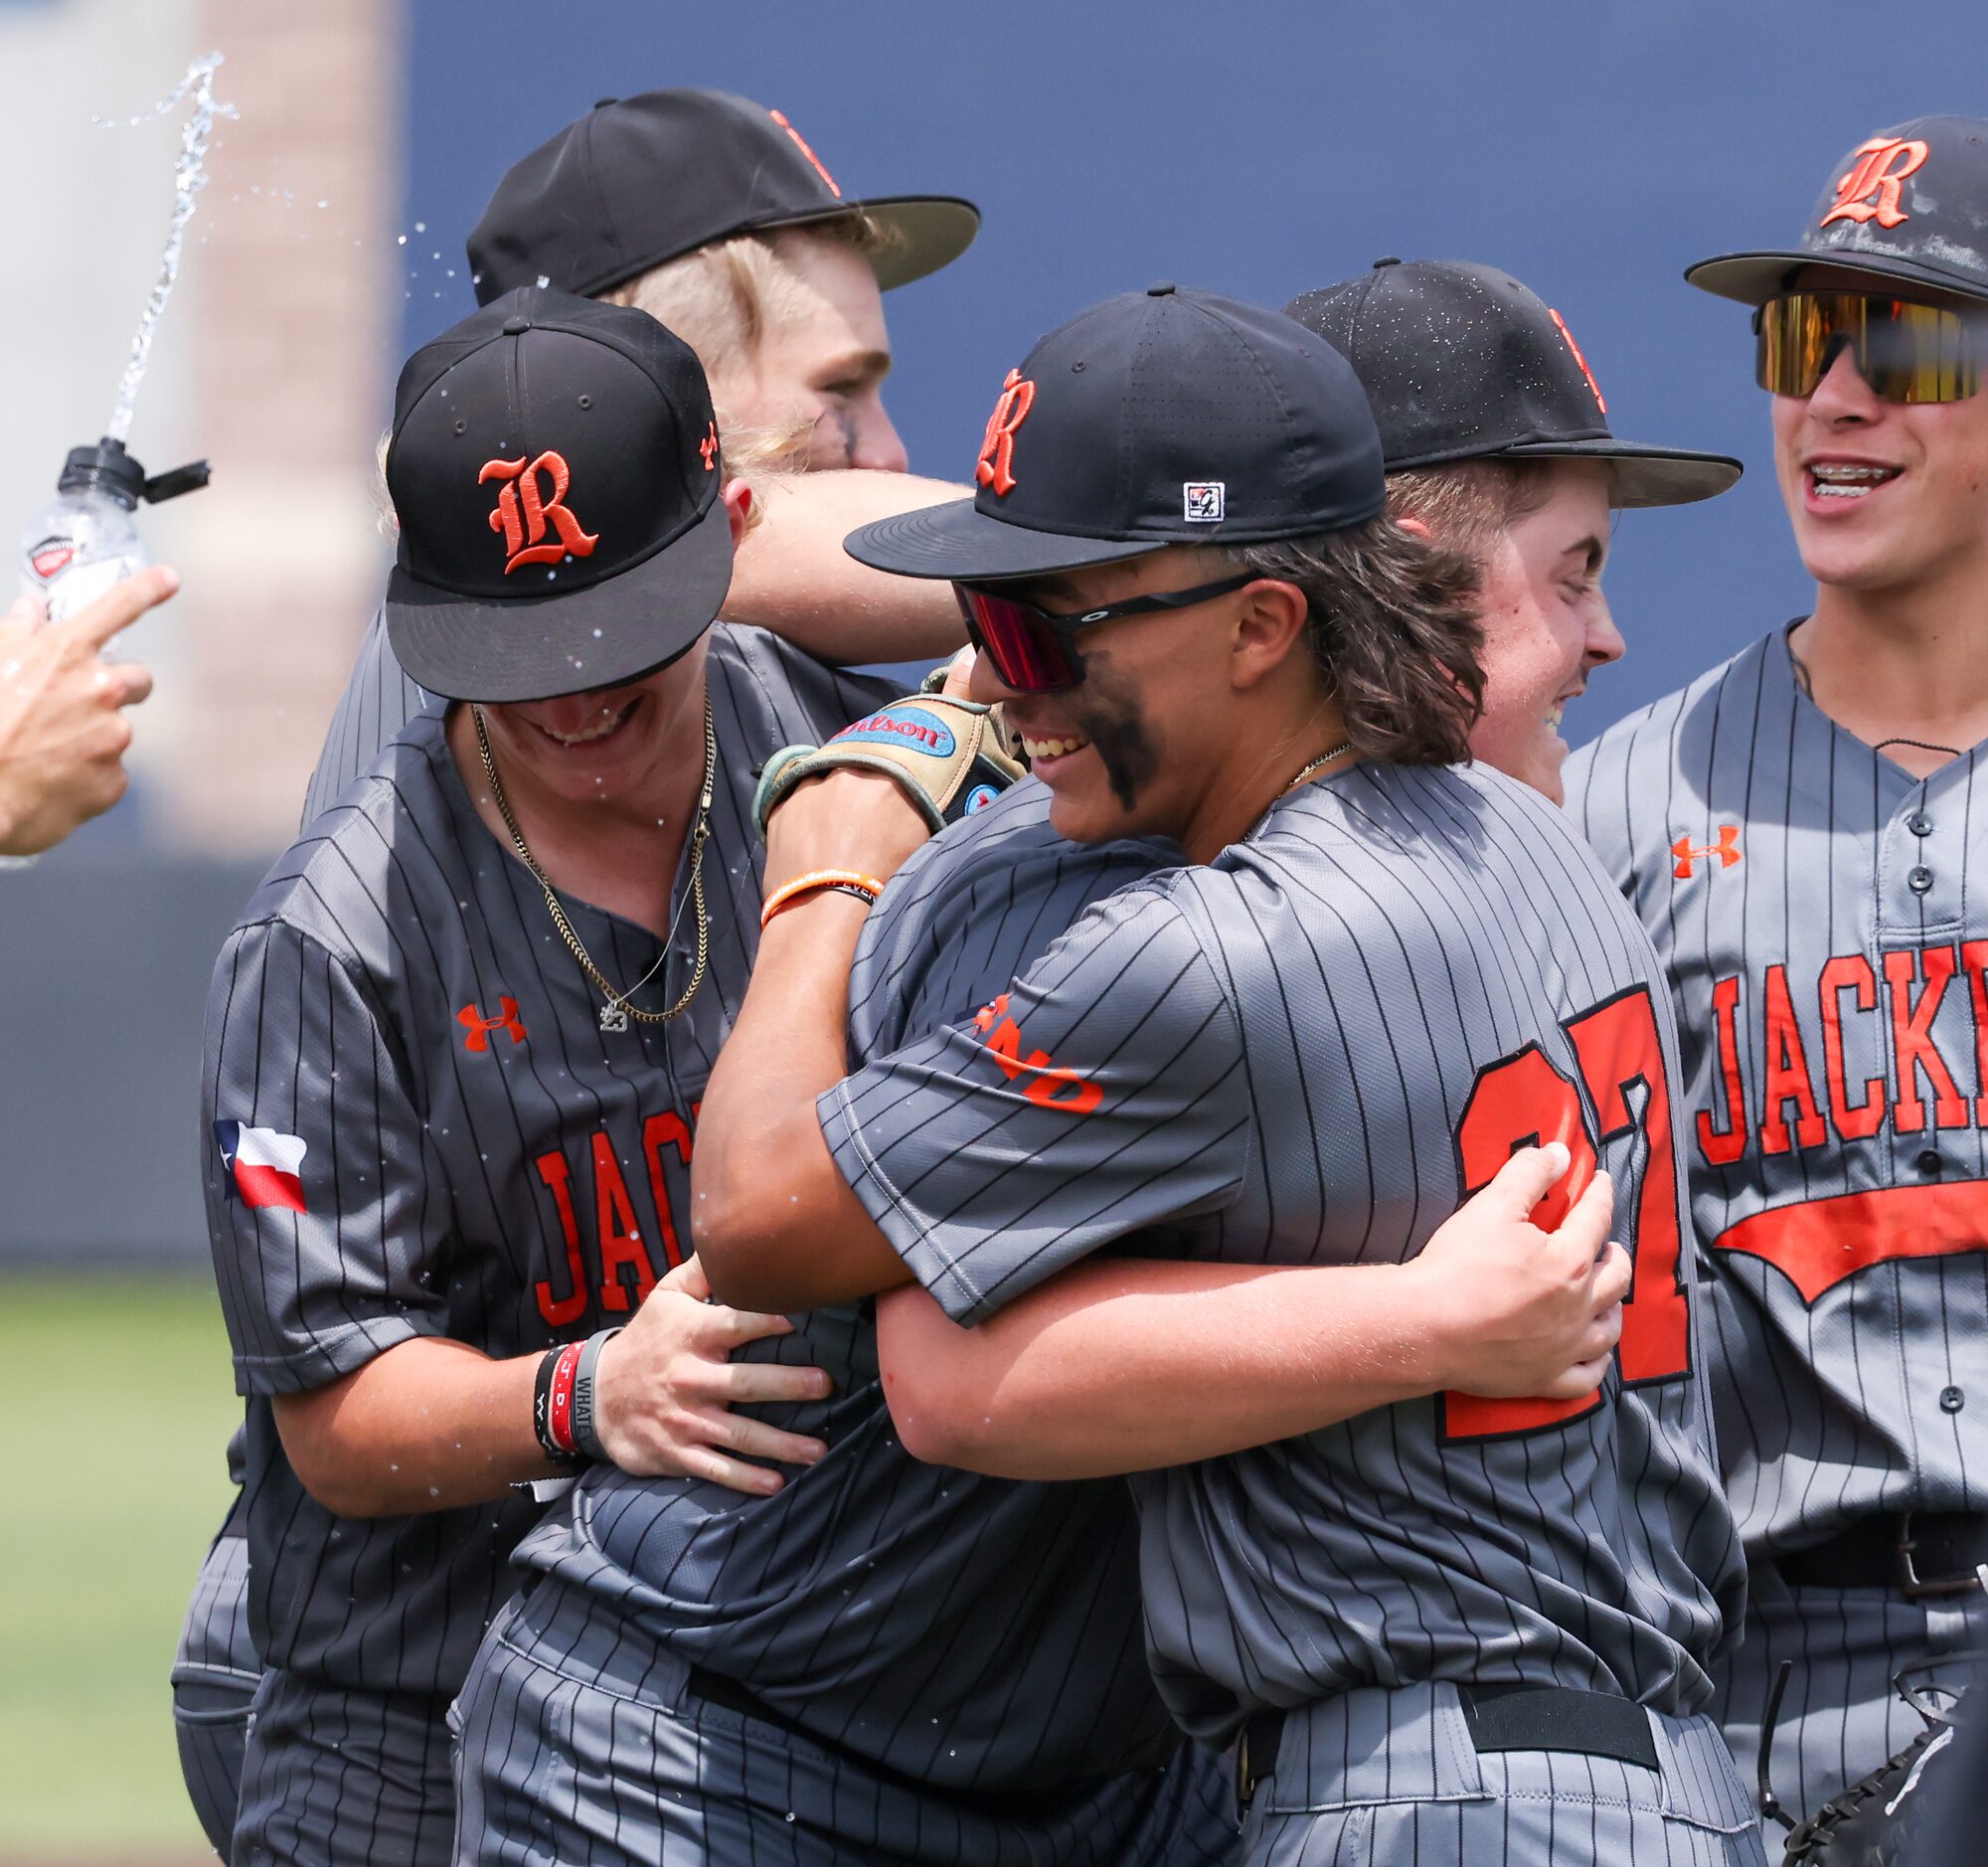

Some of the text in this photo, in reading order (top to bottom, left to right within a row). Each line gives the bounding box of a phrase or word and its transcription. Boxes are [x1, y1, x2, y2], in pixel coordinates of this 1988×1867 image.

[1820, 137, 1930, 230] R
[972, 368, 1037, 498] R
[477, 450, 599, 576] R
[535, 1102, 702, 1328] JAC
